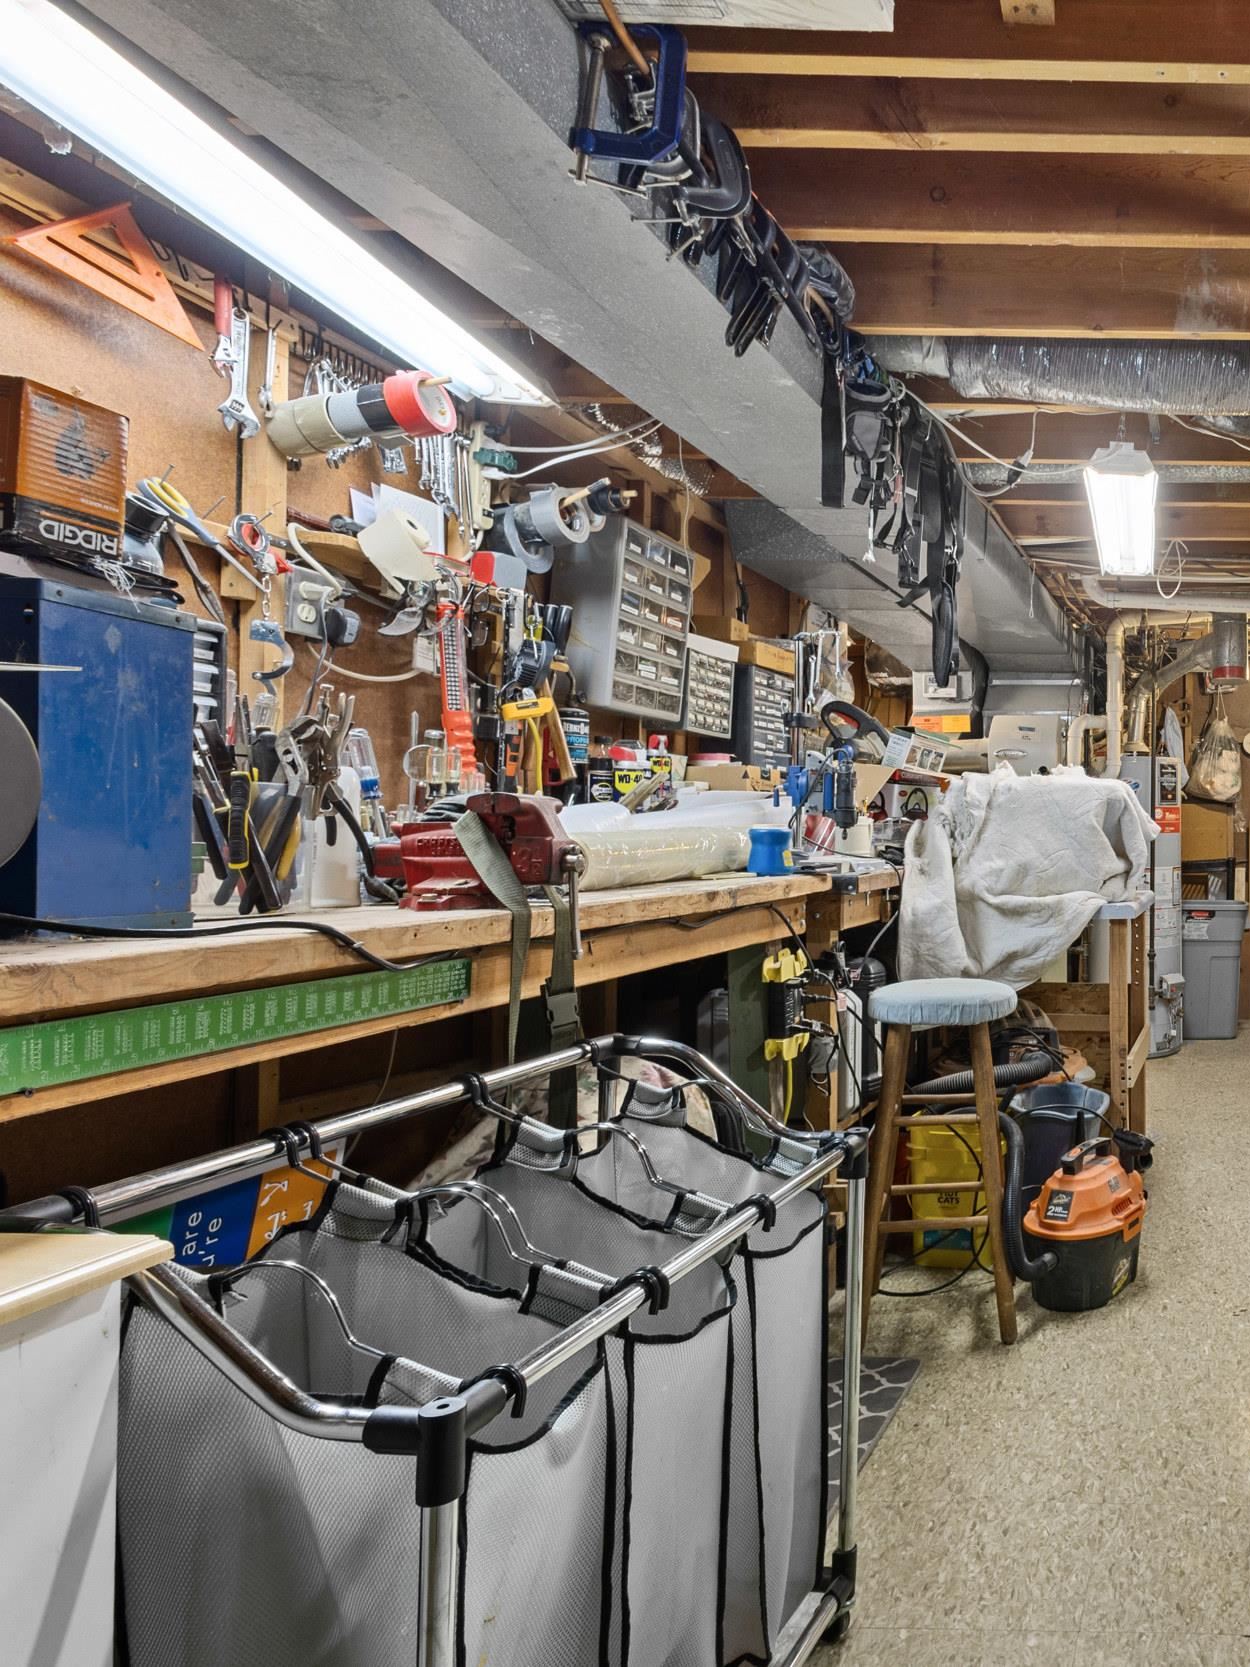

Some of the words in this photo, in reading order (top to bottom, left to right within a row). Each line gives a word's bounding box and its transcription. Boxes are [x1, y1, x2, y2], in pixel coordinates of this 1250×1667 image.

[39, 519, 118, 556] RIDGID
[937, 1196, 960, 1204] CATS
[182, 1210, 203, 1255] are
